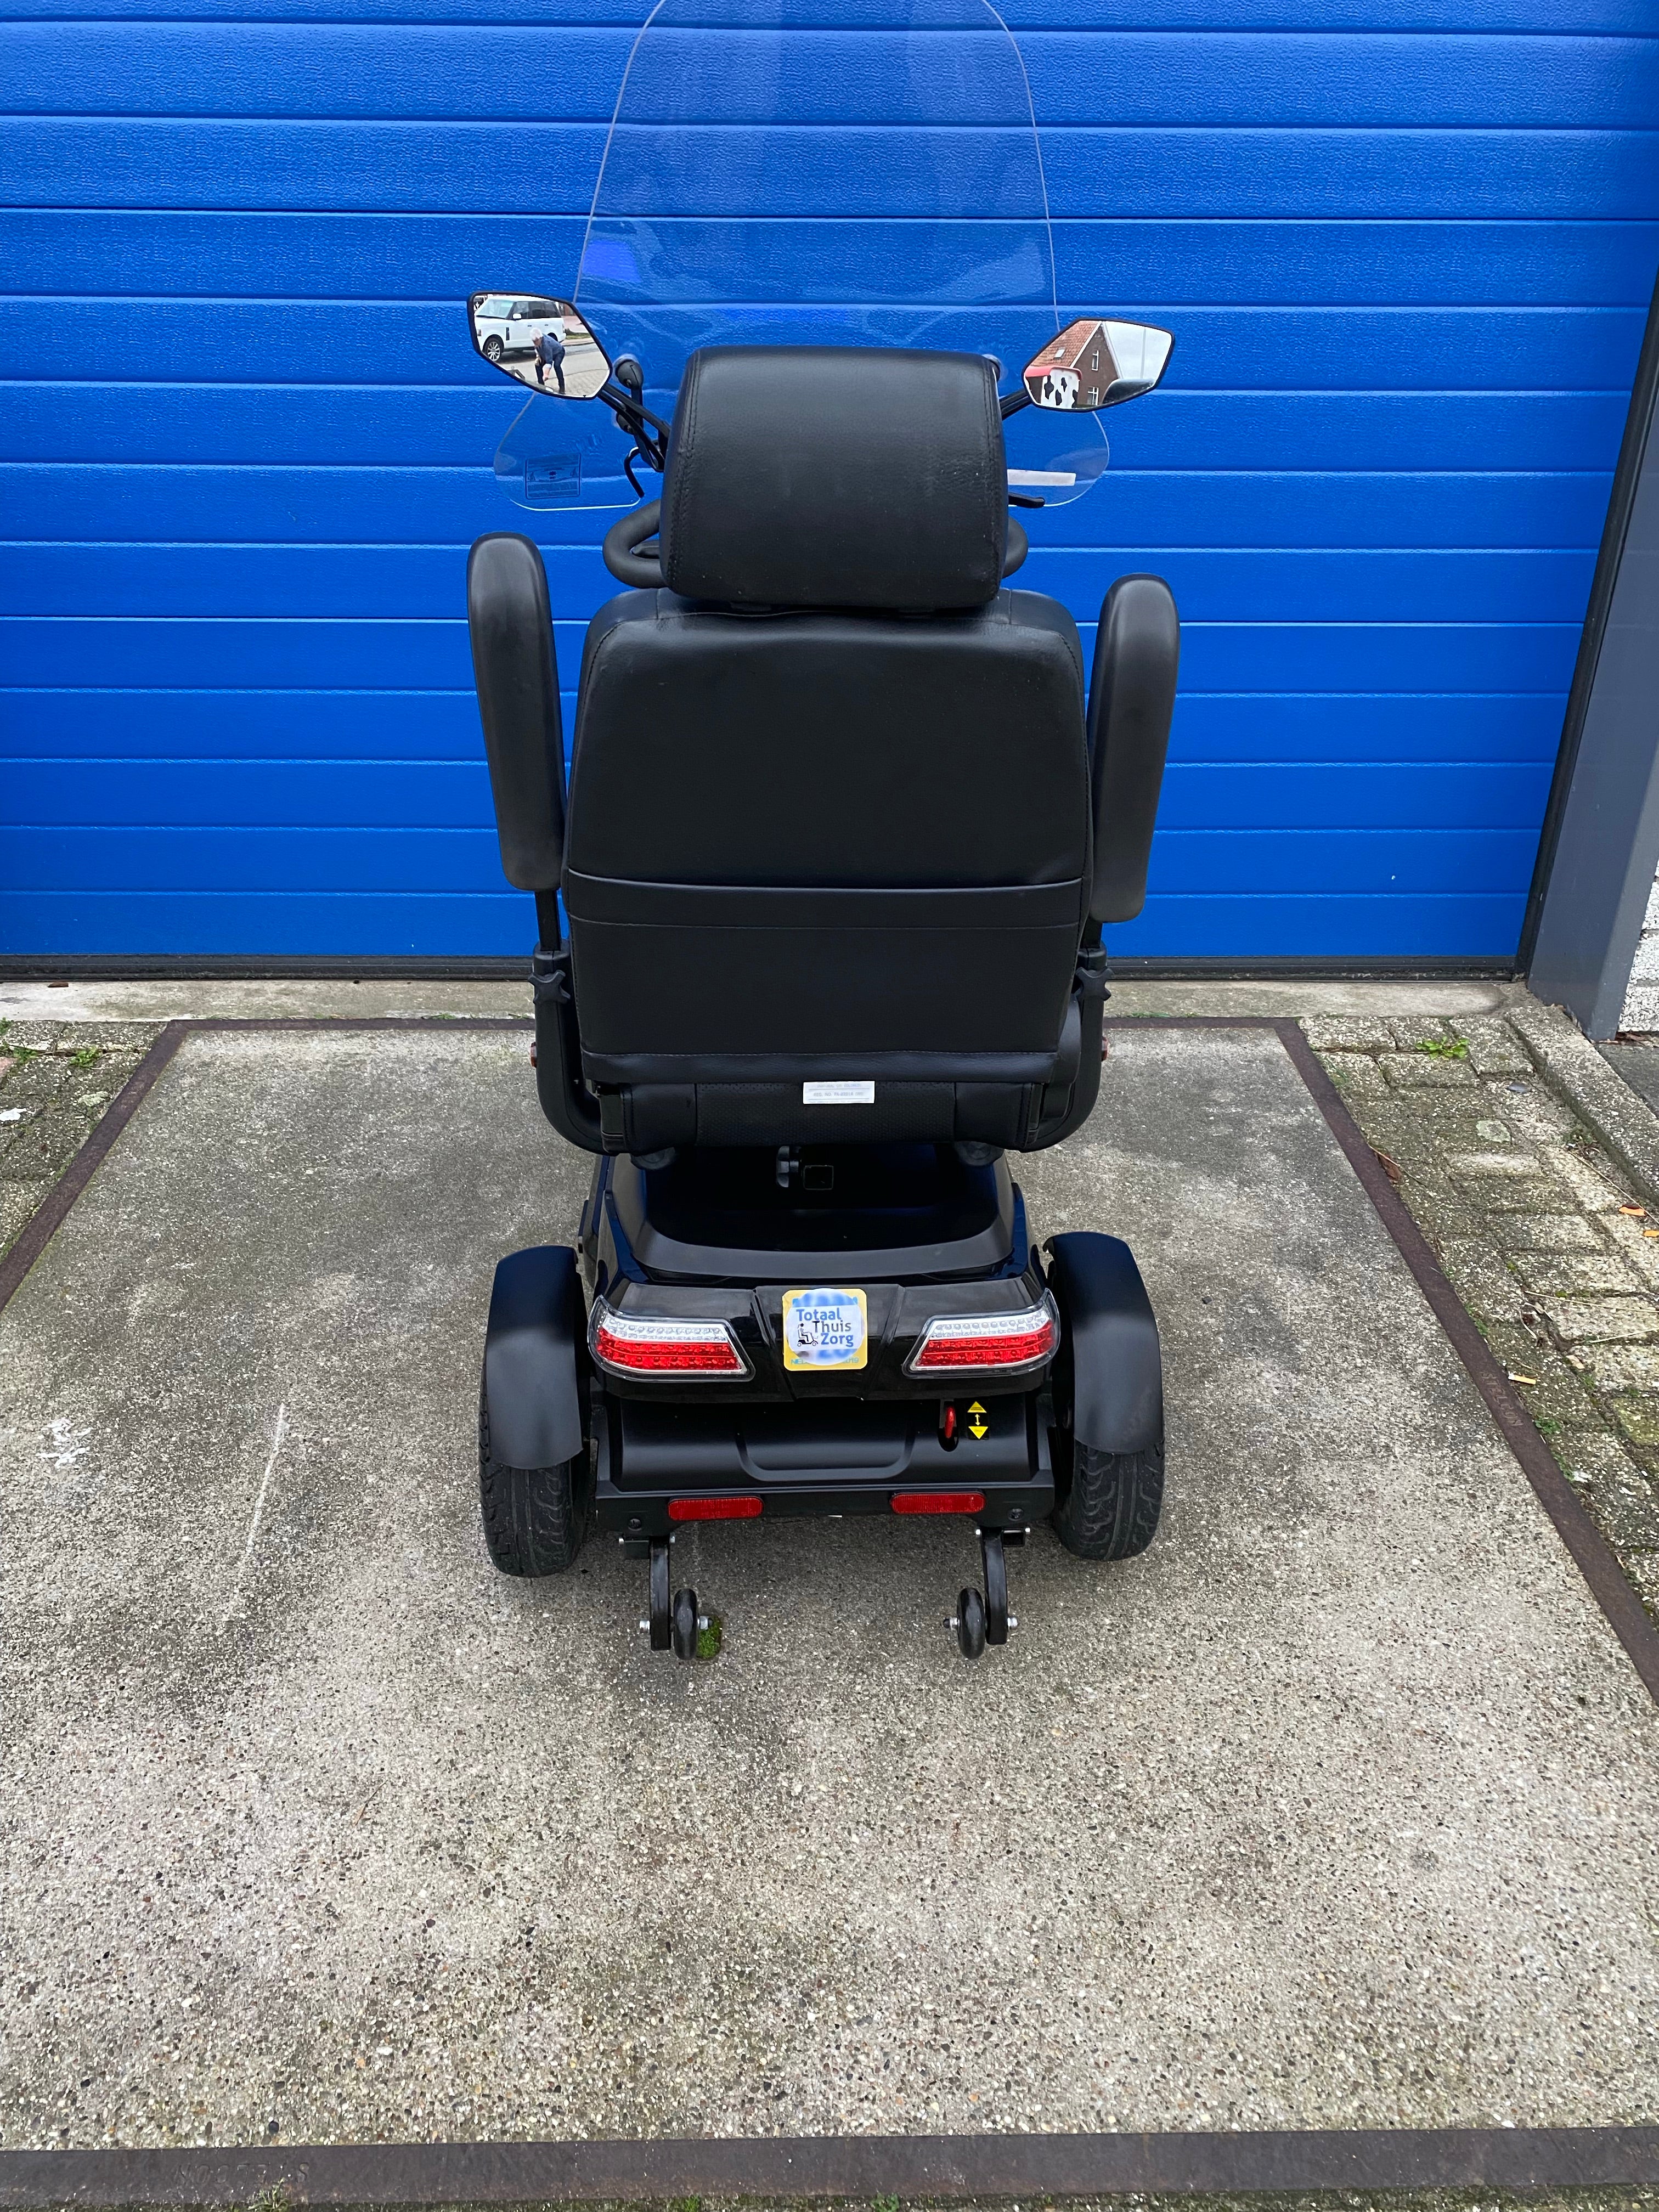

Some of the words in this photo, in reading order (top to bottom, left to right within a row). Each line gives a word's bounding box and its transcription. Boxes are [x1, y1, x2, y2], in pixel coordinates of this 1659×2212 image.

[796, 1307, 842, 1322] Totaal
[811, 1319, 852, 1333] Thuis
[821, 1333, 854, 1347] Zorg
